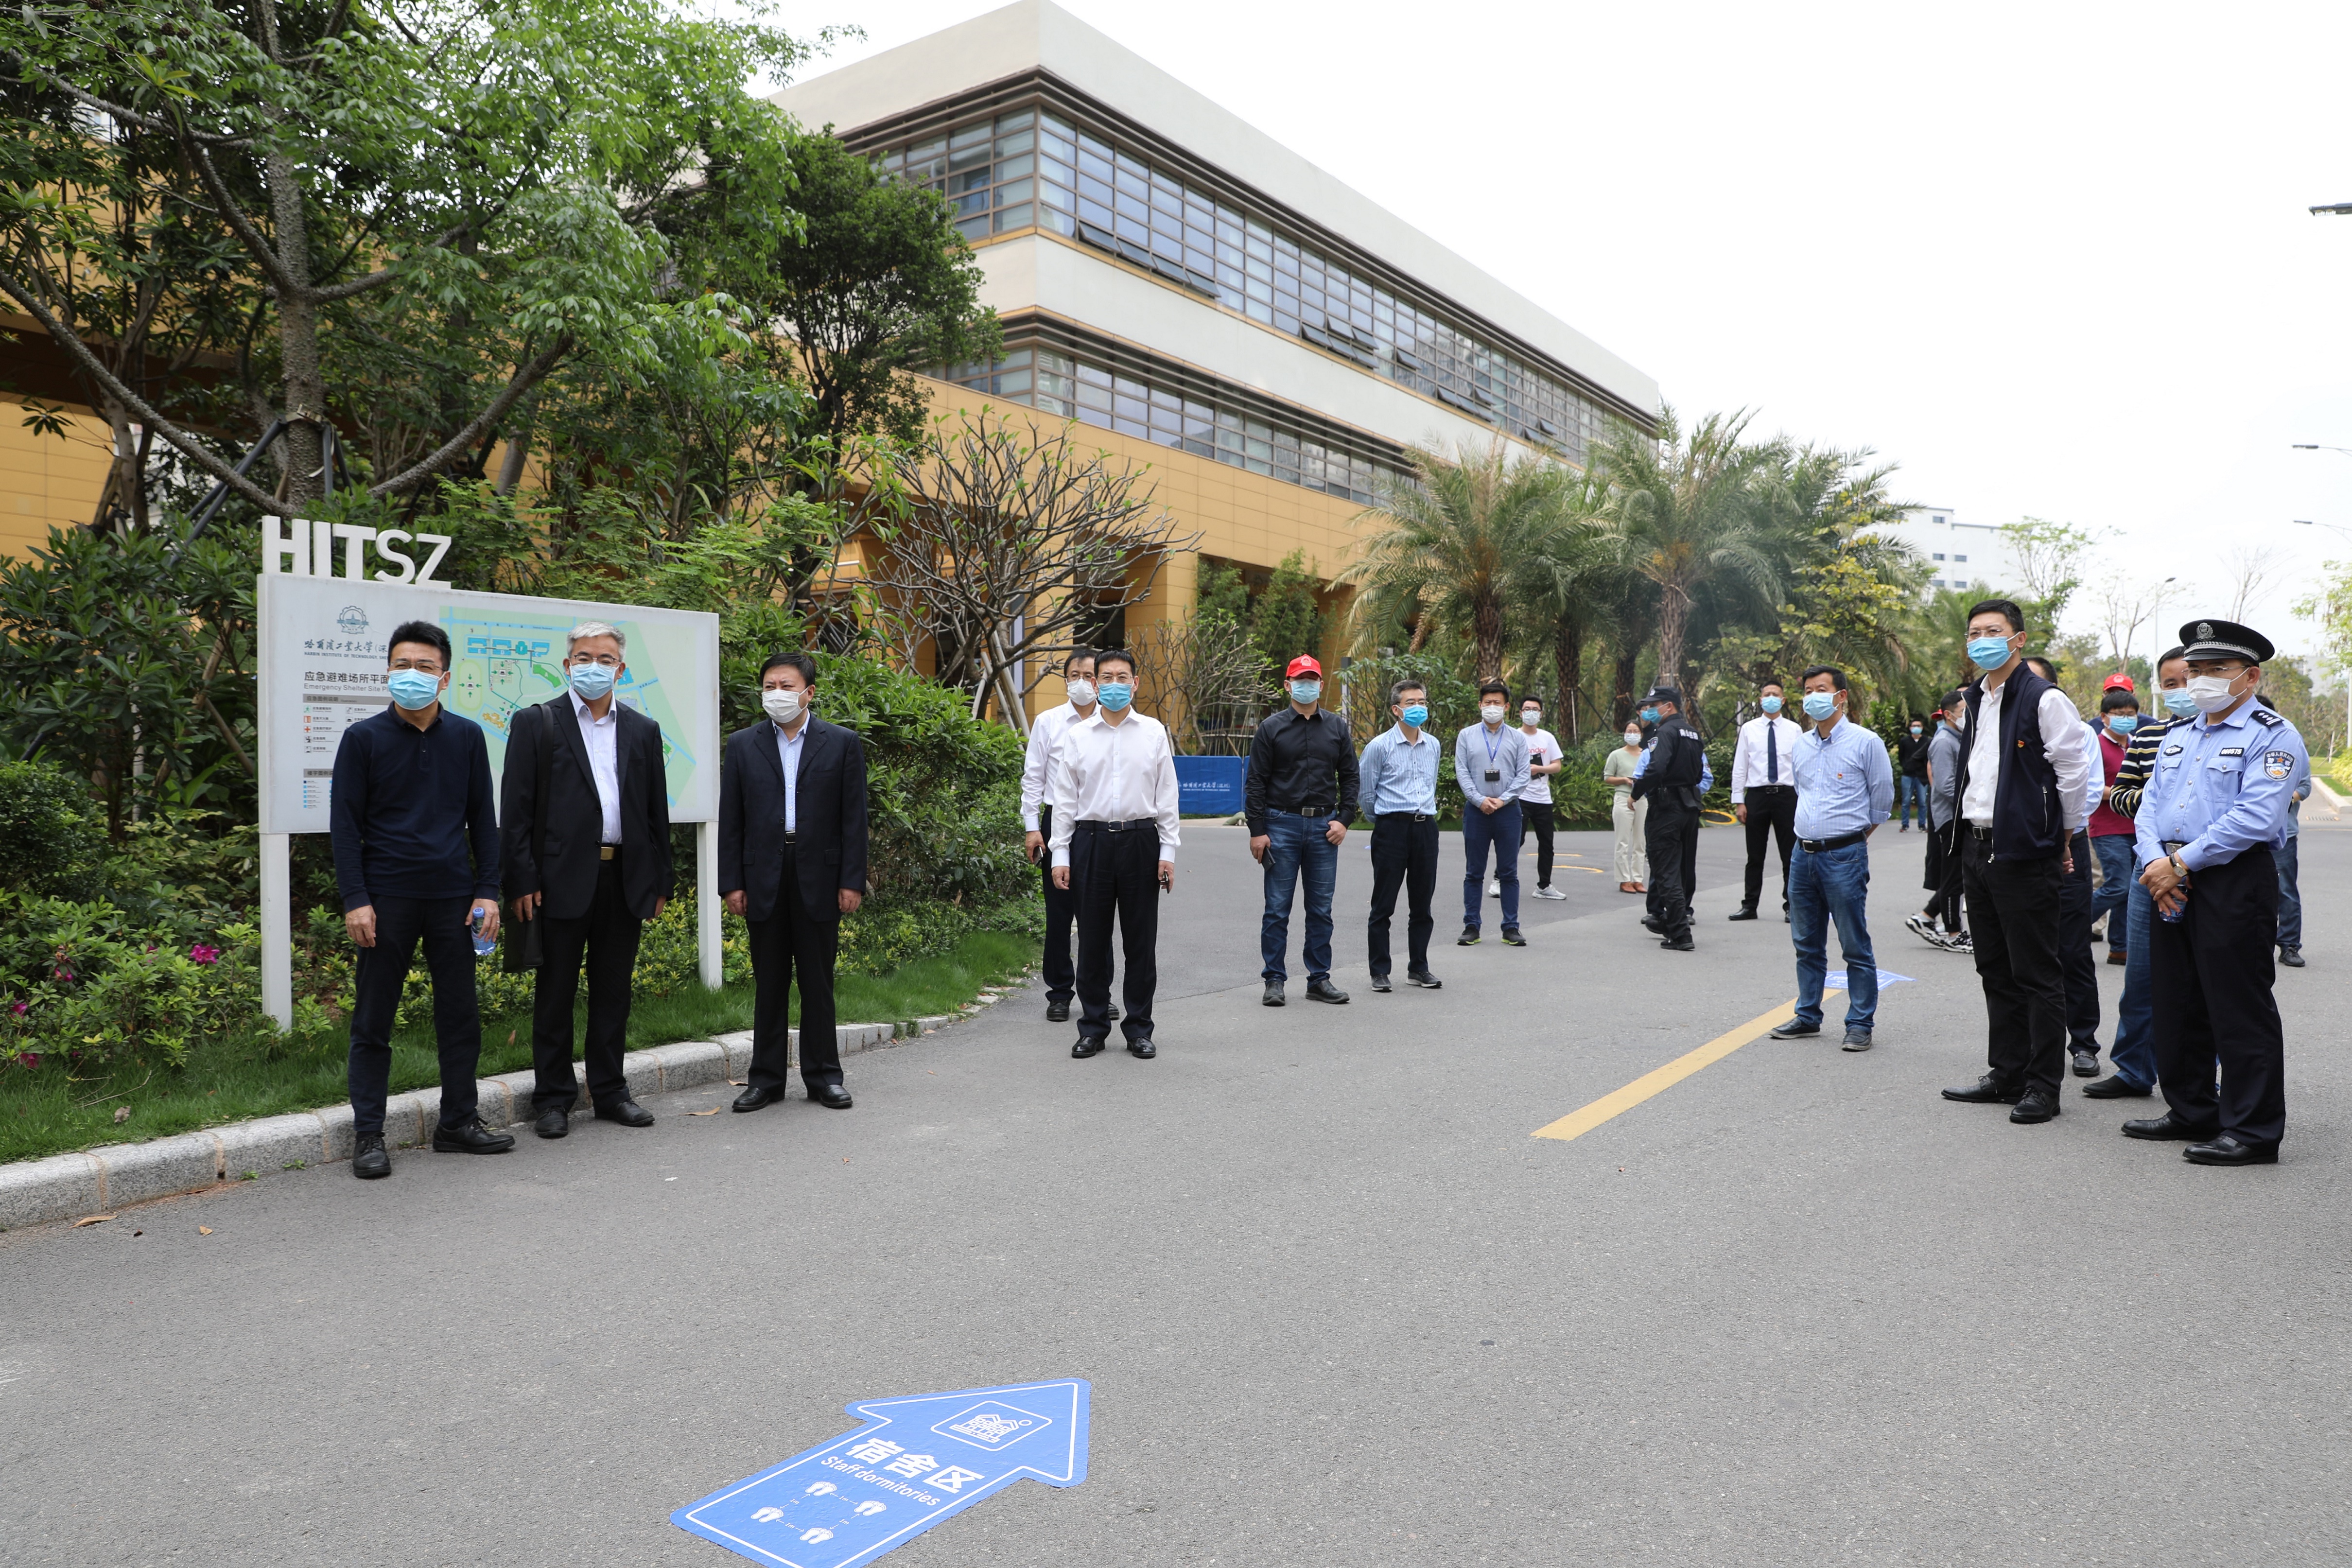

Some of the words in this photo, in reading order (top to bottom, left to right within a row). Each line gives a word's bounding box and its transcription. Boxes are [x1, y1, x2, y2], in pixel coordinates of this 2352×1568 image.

[261, 515, 452, 589] HITSZ
[304, 683, 342, 691] Emergency
[820, 1456, 865, 1474] Staff
[854, 1469, 941, 1506] dormitories
[845, 1438, 986, 1494] 宿舍区
